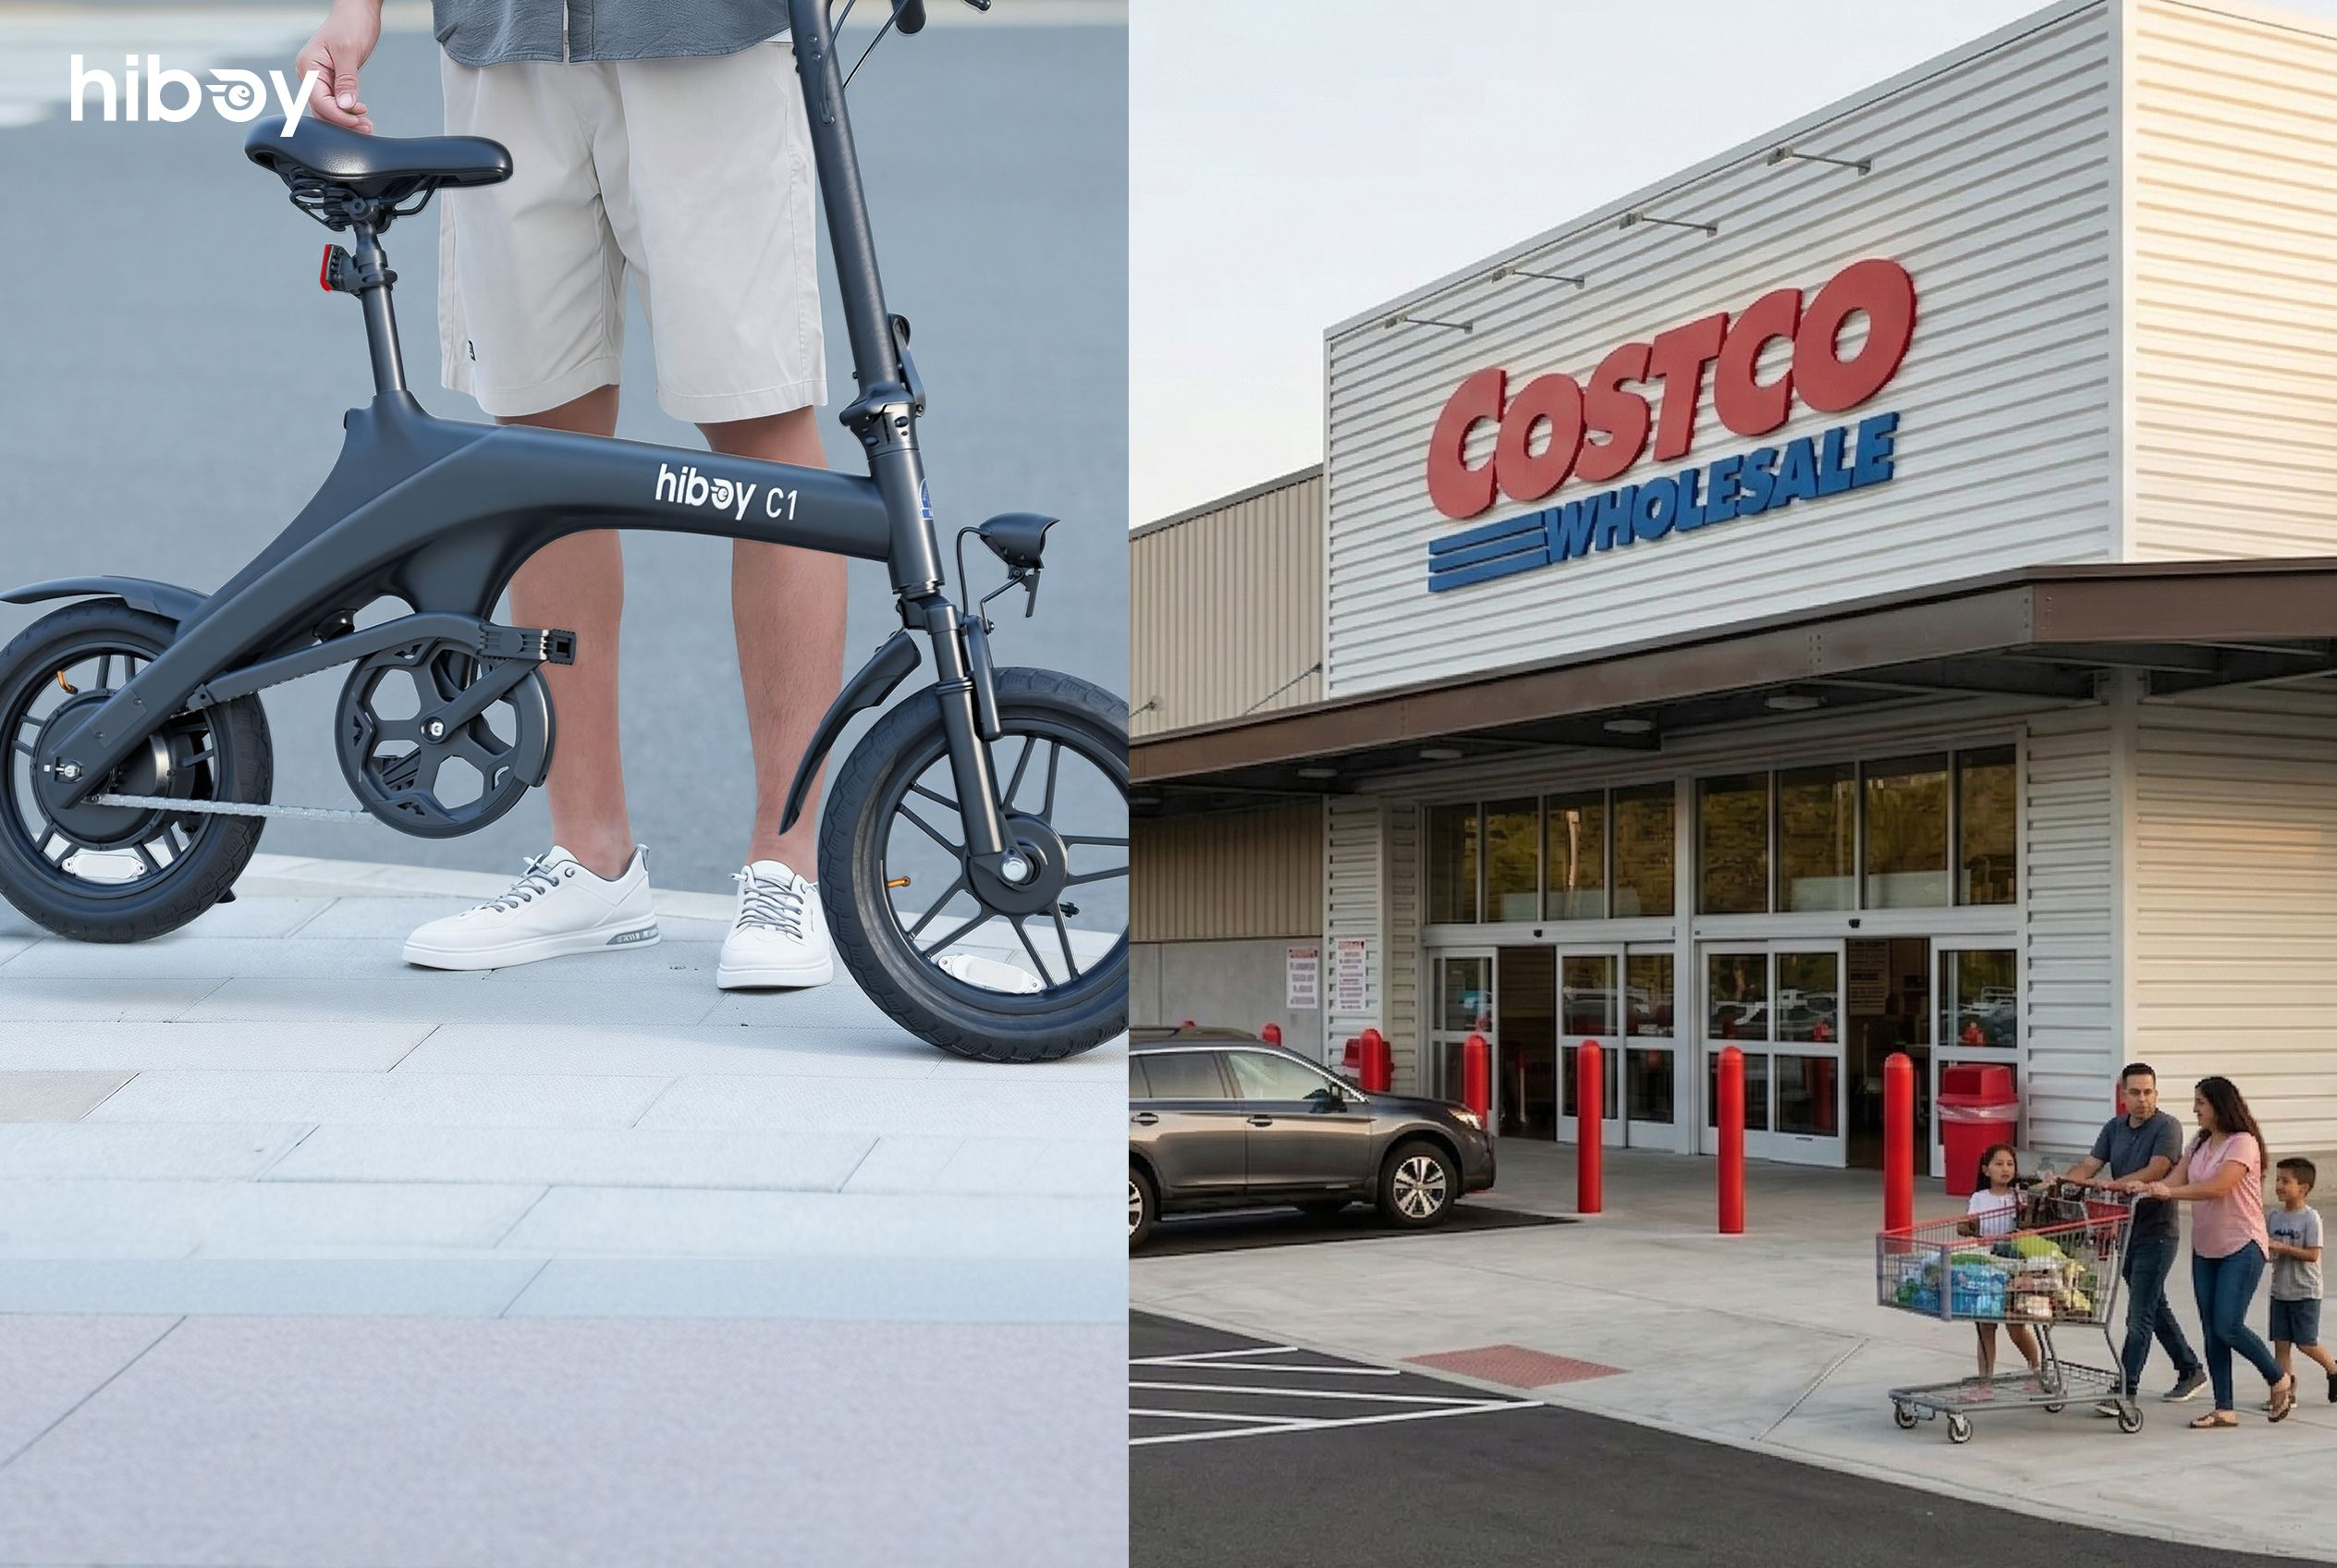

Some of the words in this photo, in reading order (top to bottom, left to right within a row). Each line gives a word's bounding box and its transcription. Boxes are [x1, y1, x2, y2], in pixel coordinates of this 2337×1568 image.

[1426, 258, 1917, 520] COSTCO
[655, 463, 757, 521] hiboy
[765, 487, 798, 521] C1
[1545, 411, 1900, 565] WHOLESALE
